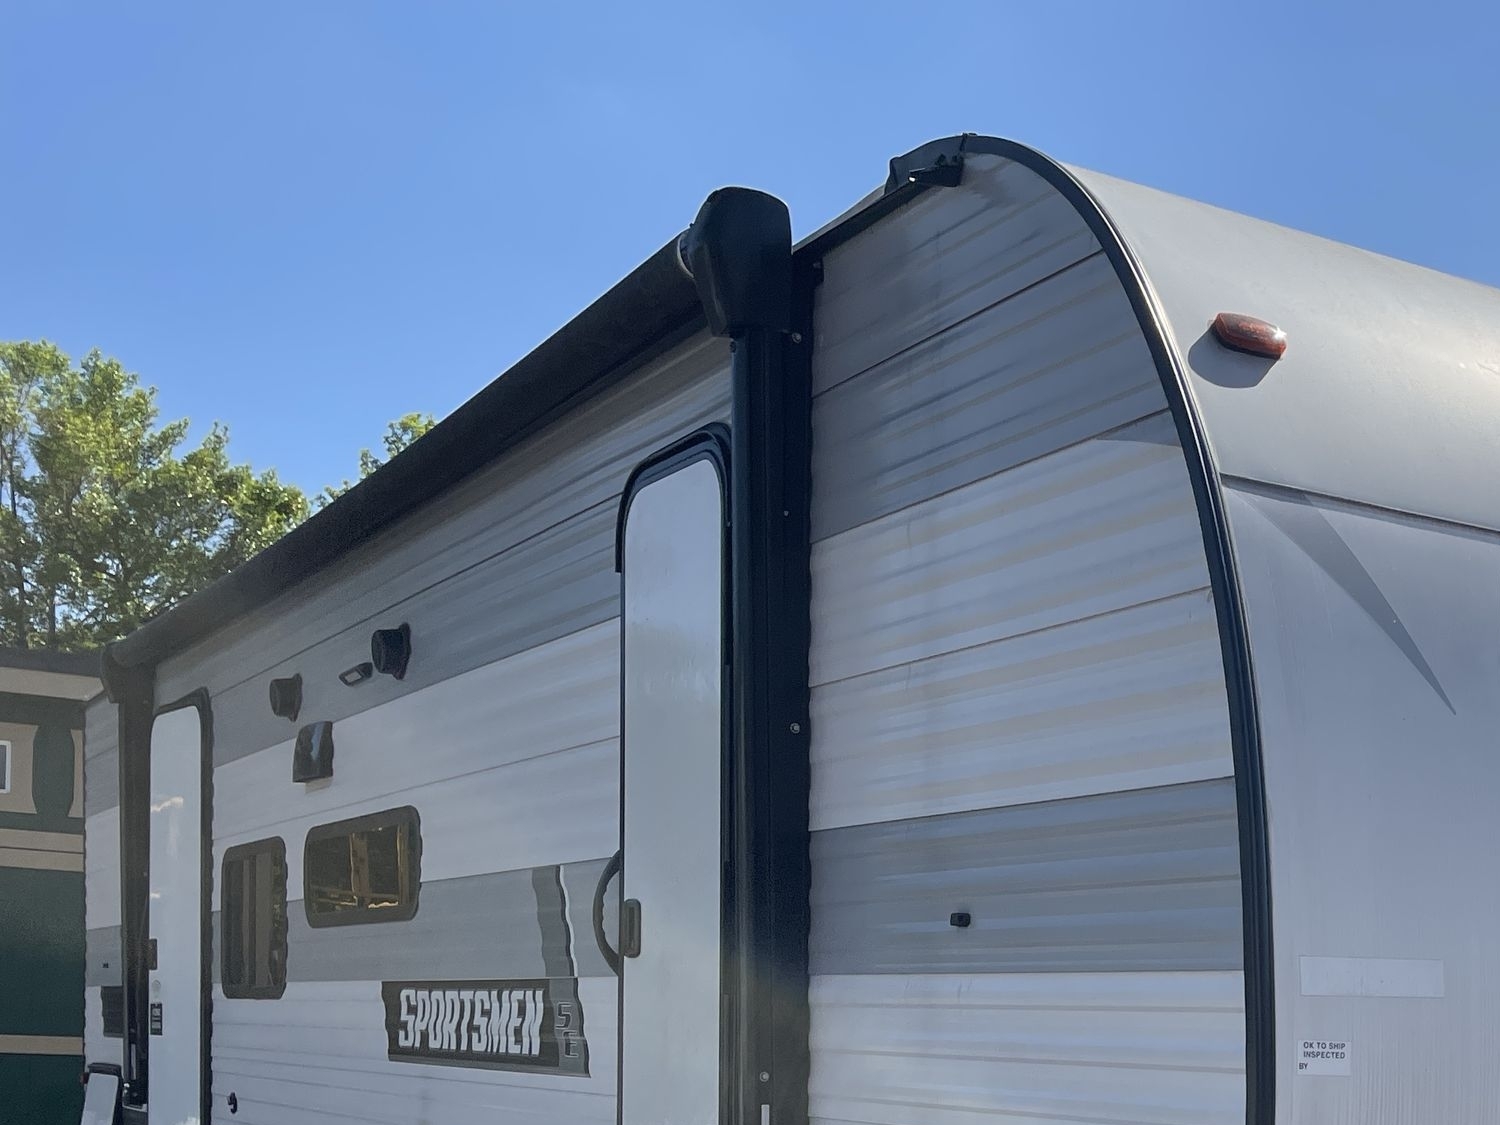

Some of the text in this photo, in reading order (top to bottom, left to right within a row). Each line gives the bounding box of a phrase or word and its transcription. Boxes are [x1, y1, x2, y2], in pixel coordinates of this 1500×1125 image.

[398, 989, 545, 1057] SPORTSMEN
[555, 1001, 580, 1058] SE
[1303, 1041, 1346, 1050] OK TO SHIP
[1303, 1050, 1346, 1059] INSPECTED
[1298, 1062, 1309, 1070] BY
